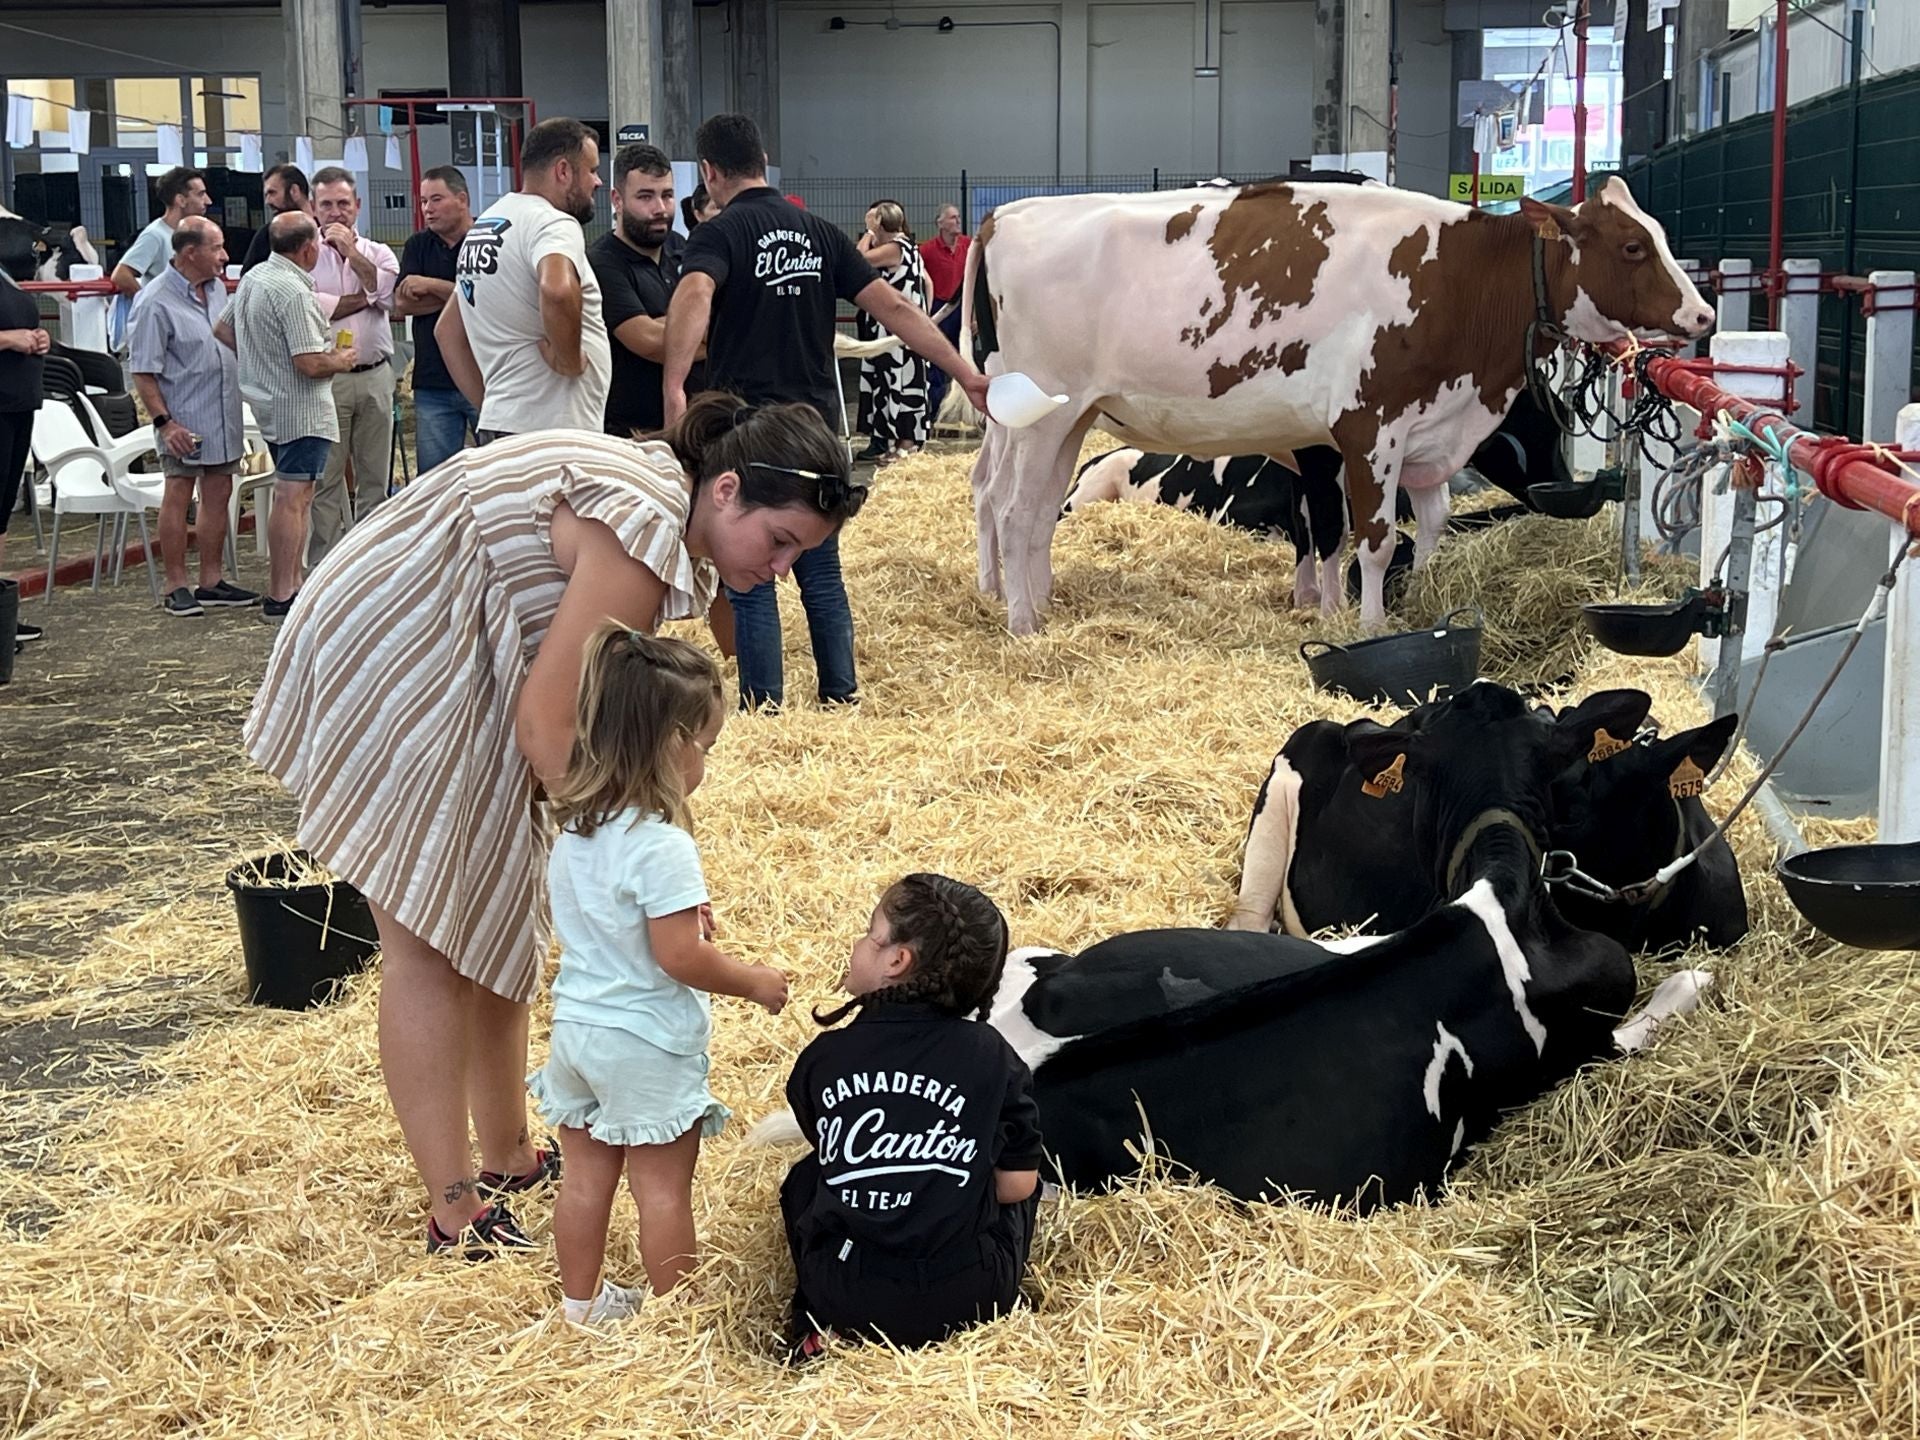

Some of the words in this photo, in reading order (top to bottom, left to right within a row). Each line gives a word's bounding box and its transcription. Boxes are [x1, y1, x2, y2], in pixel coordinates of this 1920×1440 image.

[755, 252, 773, 277] El
[1672, 779, 1703, 799] 2679
[821, 1071, 967, 1118] GANADERÍA
[816, 1115, 843, 1166] El
[843, 1108, 978, 1164] Cantón
[841, 1188, 860, 1209] EL
[867, 1190, 913, 1211] TEJO
